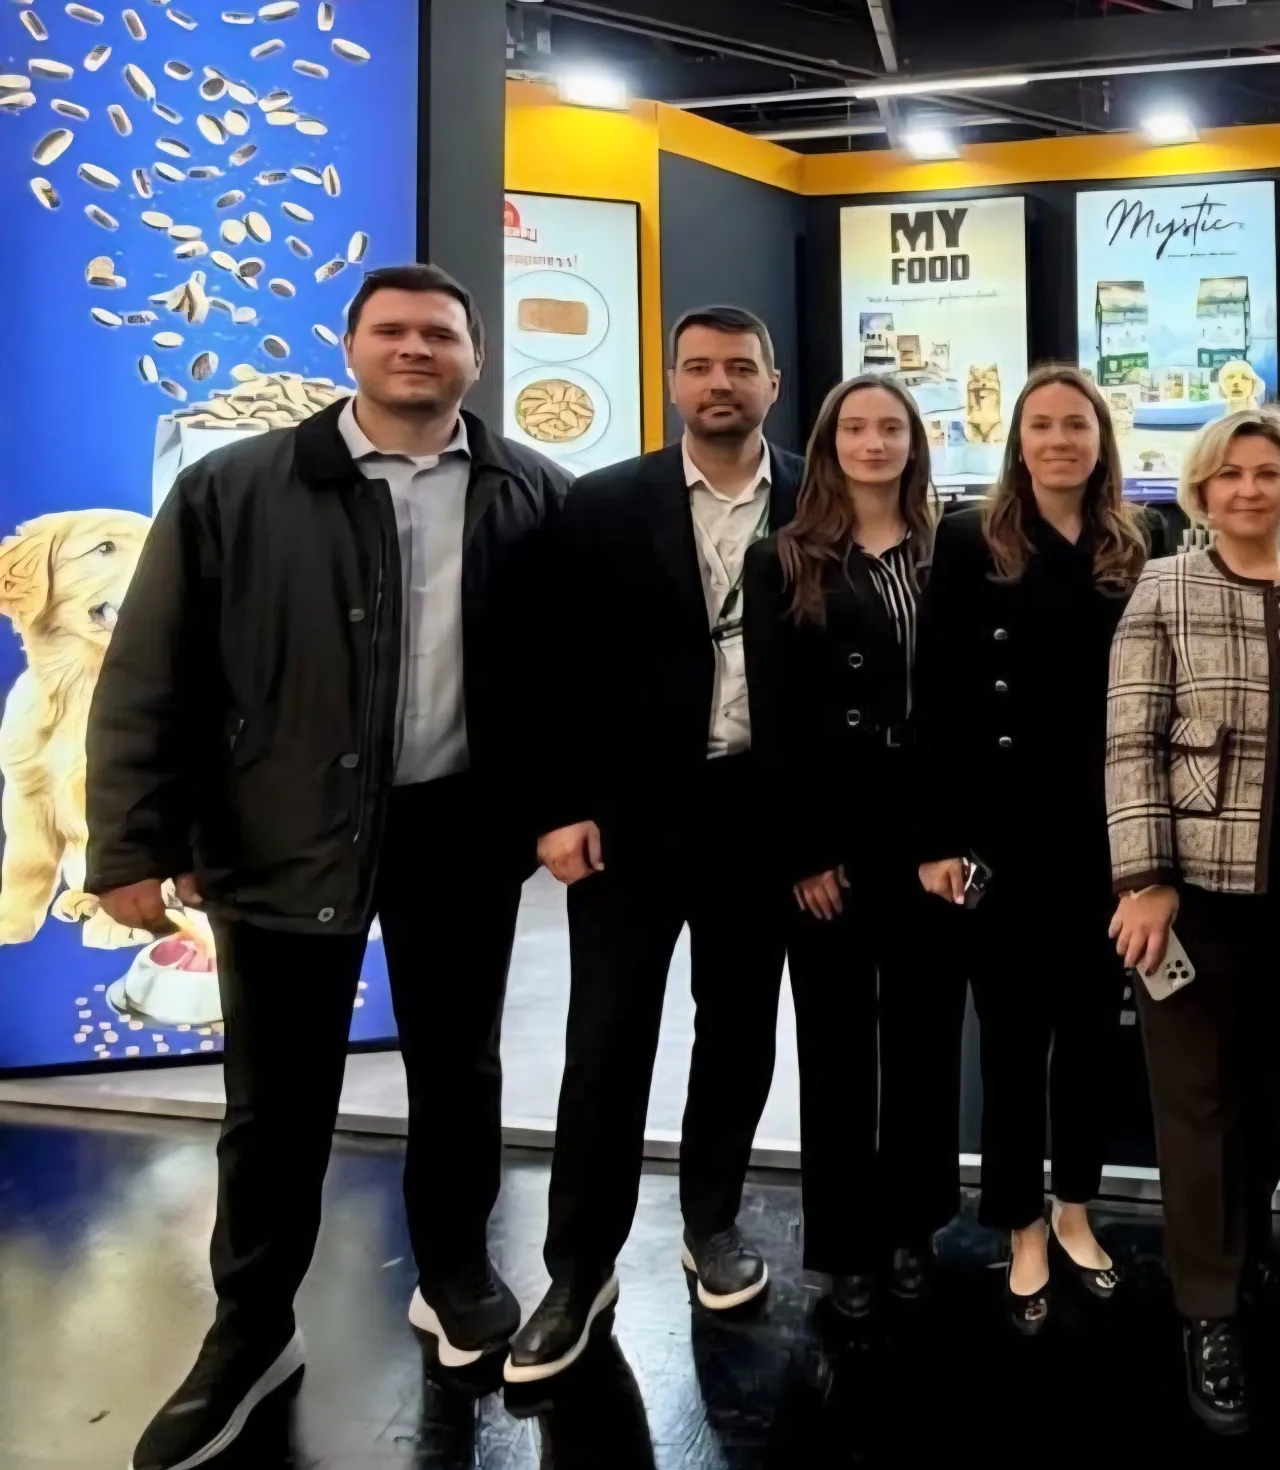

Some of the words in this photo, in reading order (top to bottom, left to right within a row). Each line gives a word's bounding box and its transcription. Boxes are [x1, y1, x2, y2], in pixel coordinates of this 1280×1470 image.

[890, 207, 968, 253] MY
[1106, 192, 1241, 260] Mystic
[891, 254, 970, 285] FOOD
